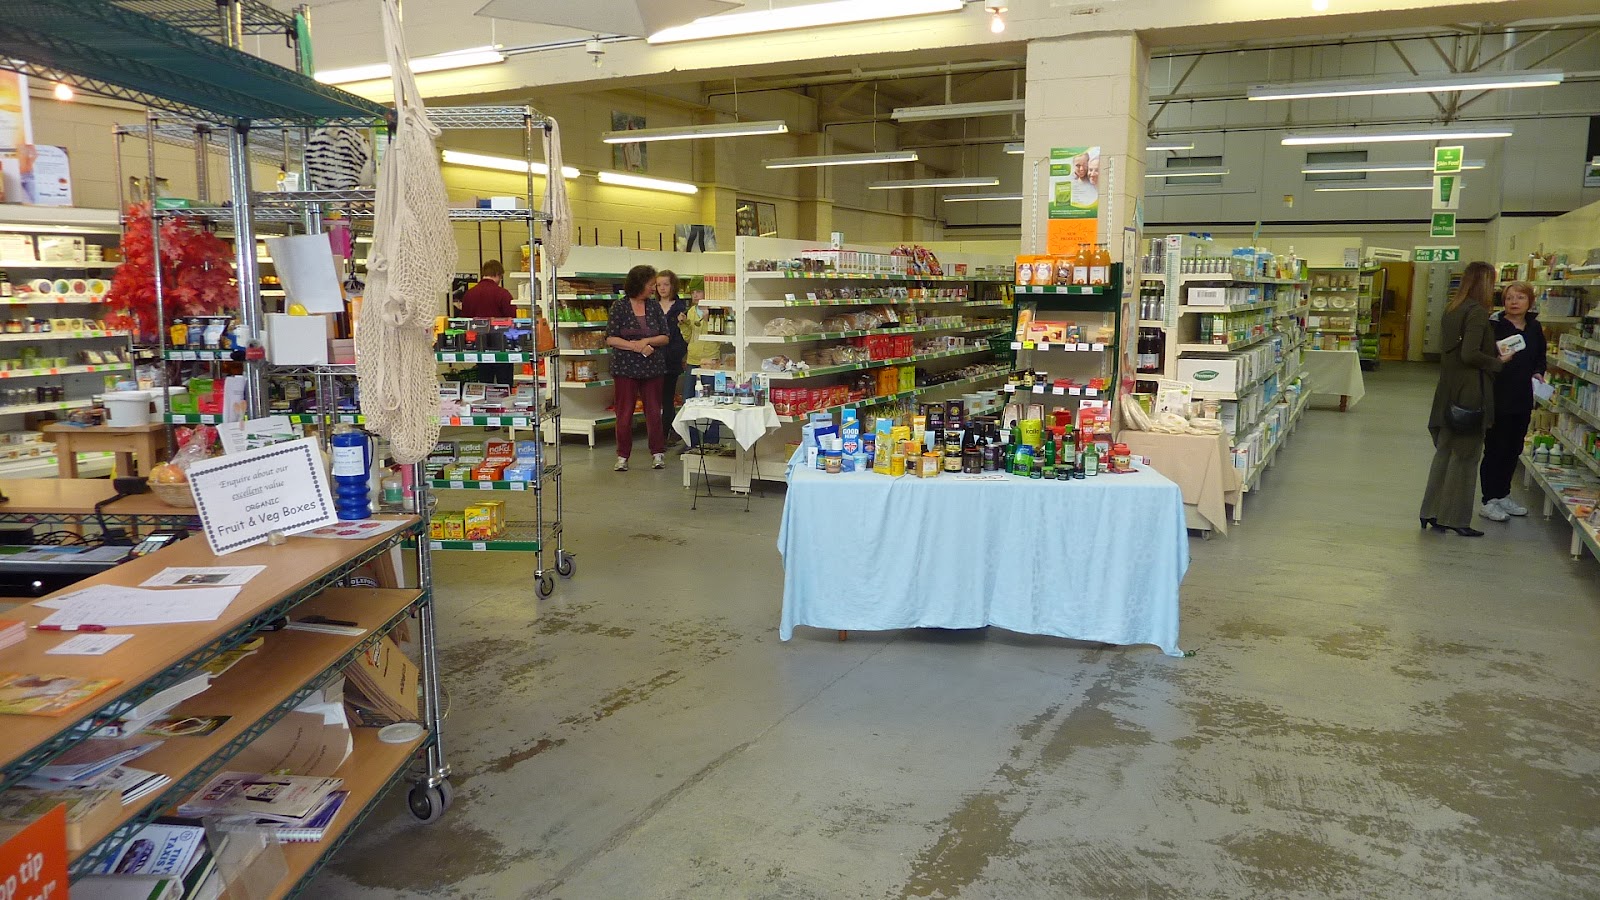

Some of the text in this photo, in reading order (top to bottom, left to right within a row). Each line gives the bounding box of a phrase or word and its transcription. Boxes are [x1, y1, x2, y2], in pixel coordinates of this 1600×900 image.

[219, 465, 289, 488] Enquire about our
[232, 479, 285, 501] excellent value
[245, 497, 280, 512] ORGANIC
[217, 501, 317, 536] Fruit & Veg Boxes
[156, 836, 179, 867] TAXIS
[19, 852, 44, 885] tip
